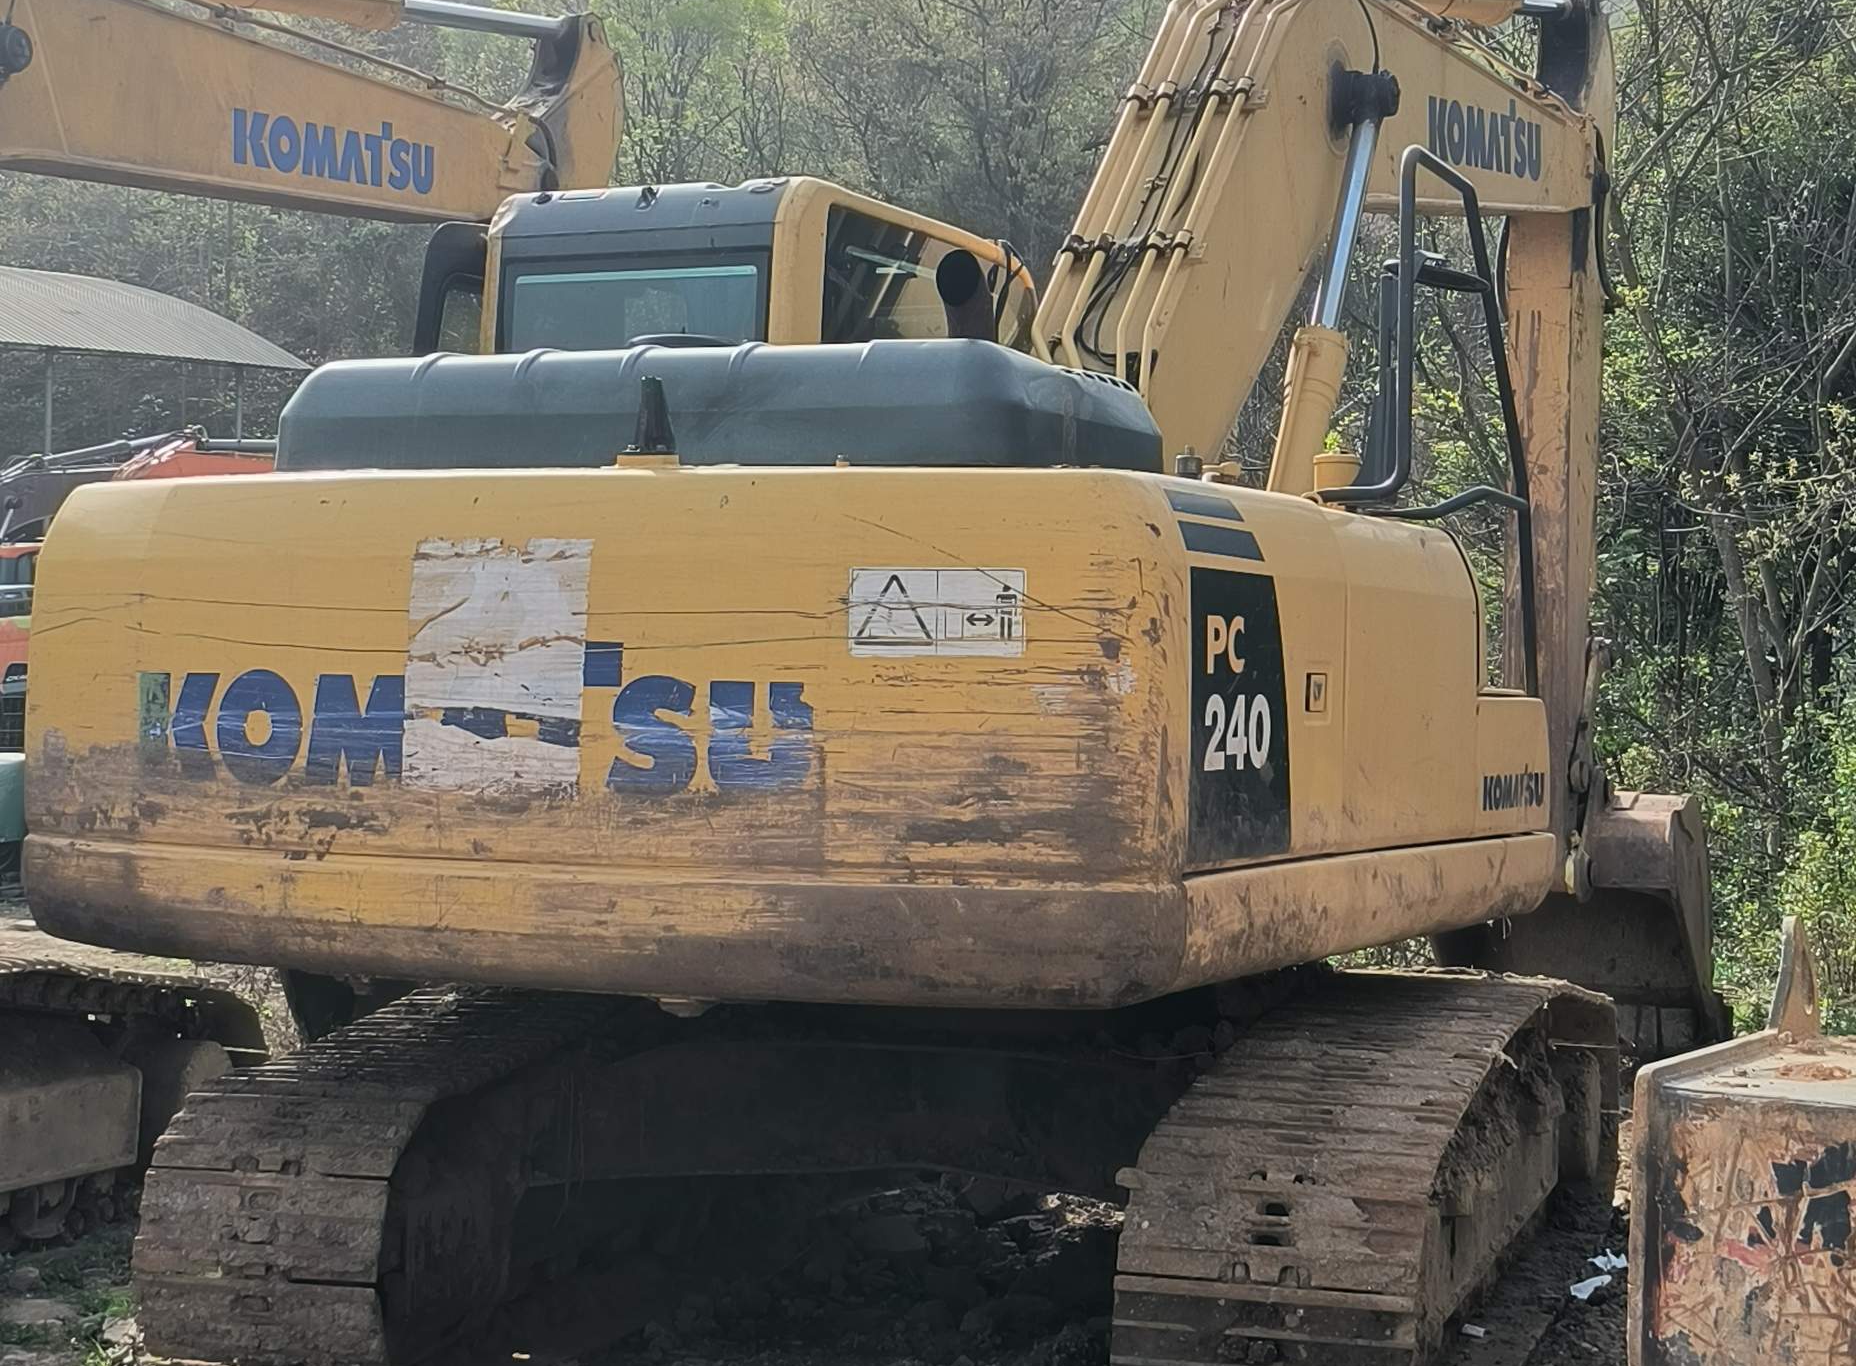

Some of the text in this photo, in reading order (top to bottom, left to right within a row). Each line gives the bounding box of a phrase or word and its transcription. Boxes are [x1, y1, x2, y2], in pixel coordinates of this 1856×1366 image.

[232, 107, 435, 195] KOMATSU
[1428, 95, 1542, 182] KOMATSU
[1206, 614, 1246, 675] PC
[137, 641, 814, 795] KOMSU
[1203, 693, 1272, 772] 240
[1482, 763, 1545, 812] KOMATSU
